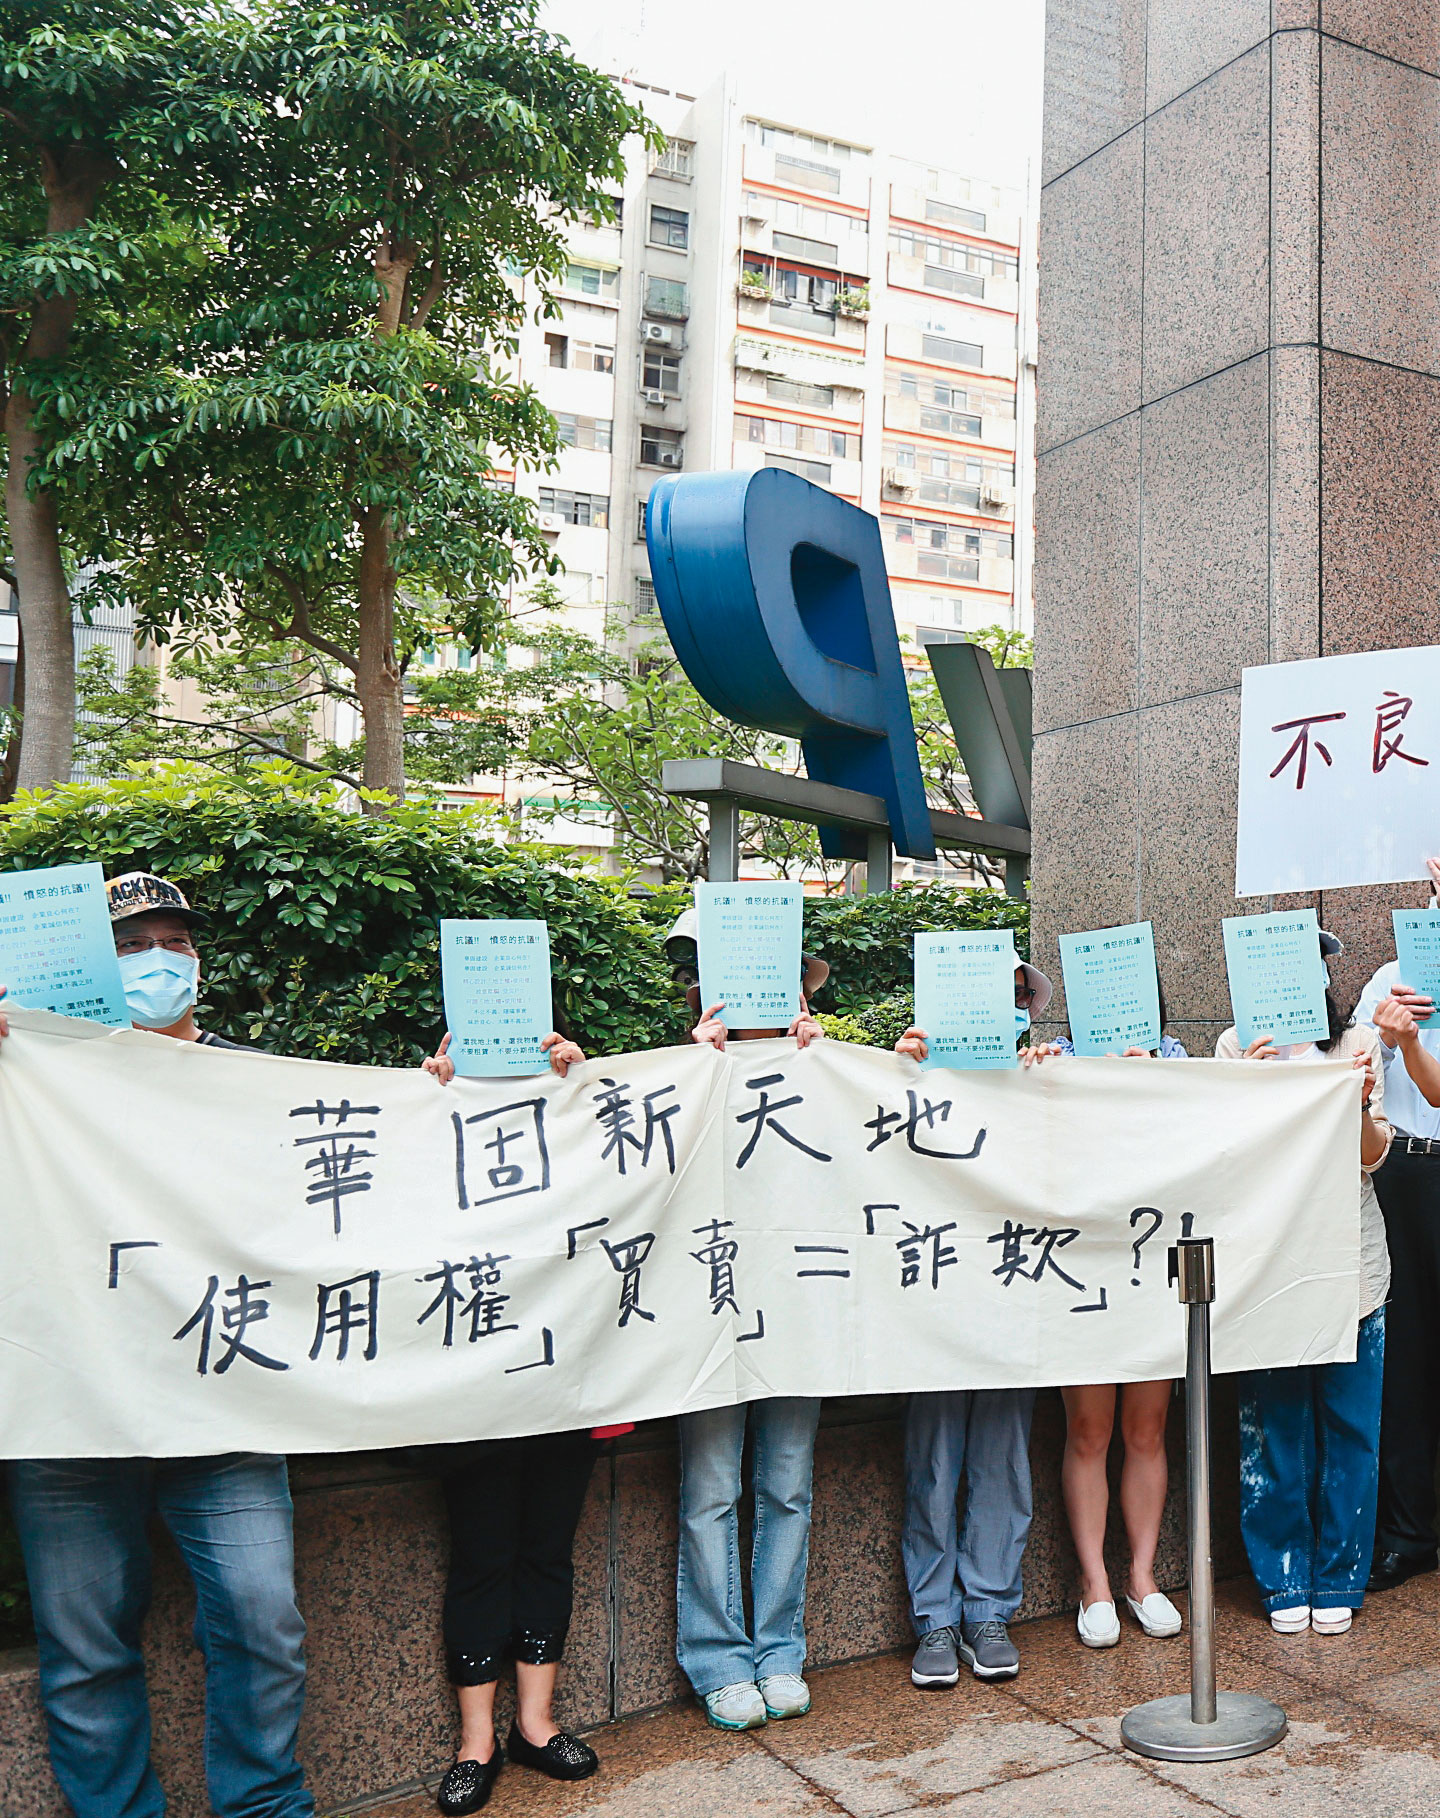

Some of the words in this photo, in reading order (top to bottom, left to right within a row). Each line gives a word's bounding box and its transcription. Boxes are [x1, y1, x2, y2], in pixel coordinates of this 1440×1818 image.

[288, 1072, 989, 1235] 華固新天地
